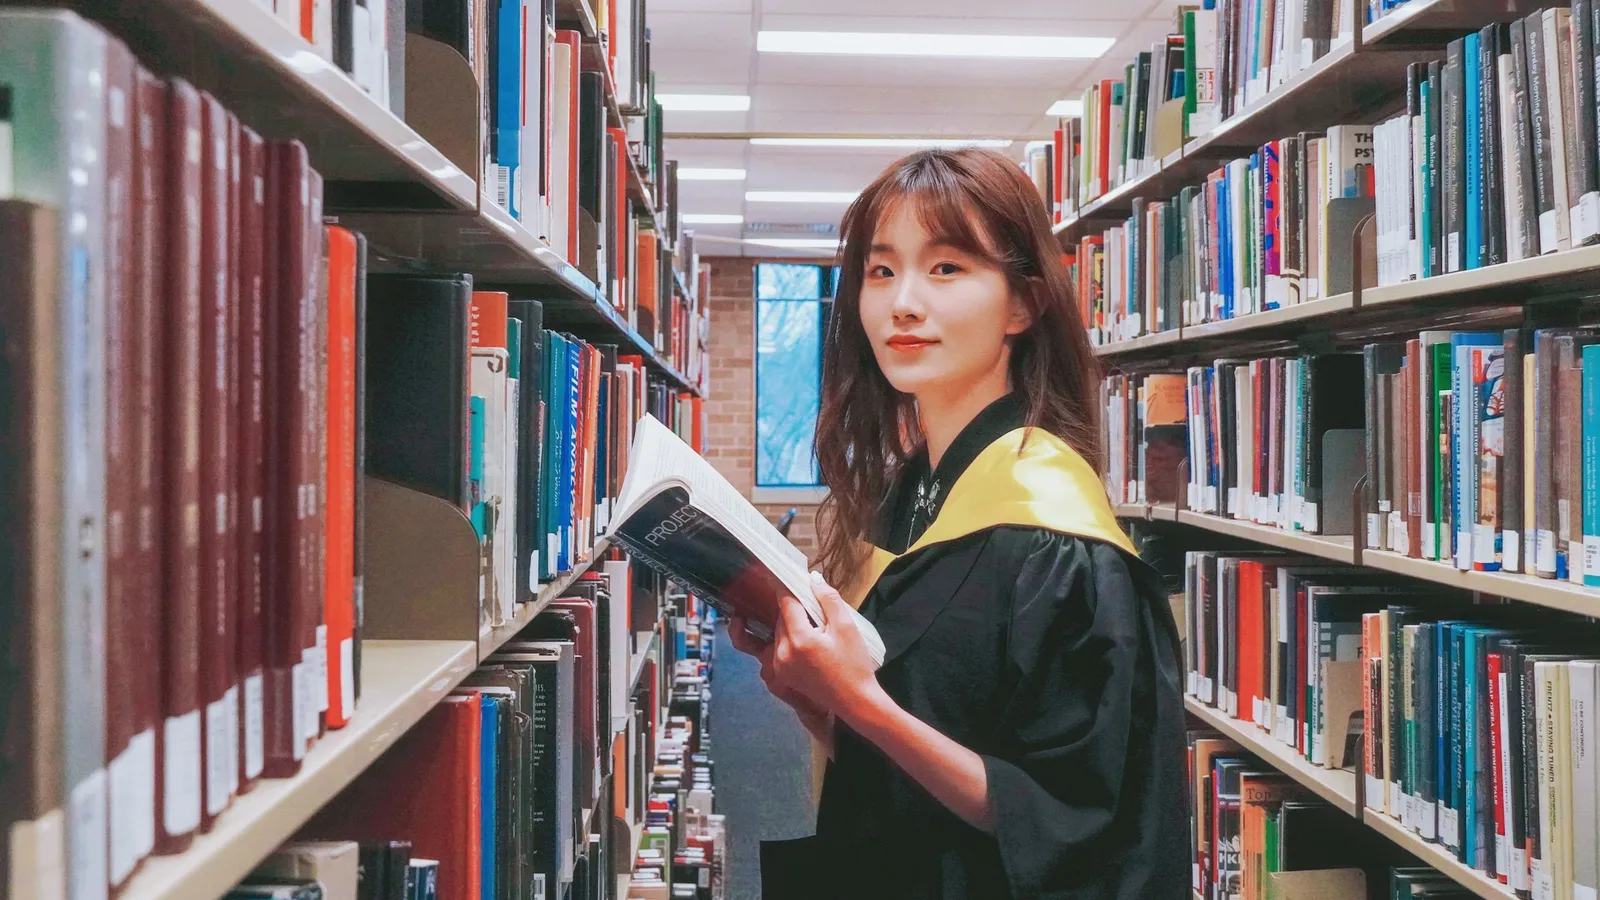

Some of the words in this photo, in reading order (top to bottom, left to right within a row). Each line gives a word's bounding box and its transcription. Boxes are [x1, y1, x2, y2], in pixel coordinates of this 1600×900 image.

[1530, 32, 1539, 75] Saturday
[1354, 133, 1374, 143] TH
[571, 363, 579, 417] FILM
[615, 541, 703, 597] PROJECTIONS
[703, 595, 719, 605] 5
[1526, 669, 1534, 719] WOMEN
[1580, 700, 1584, 710] TO
[1580, 710, 1584, 719] BE
[1452, 737, 1458, 754] TV
[1527, 734, 1535, 768] SOAP
[1528, 769, 1536, 809] OPERA
